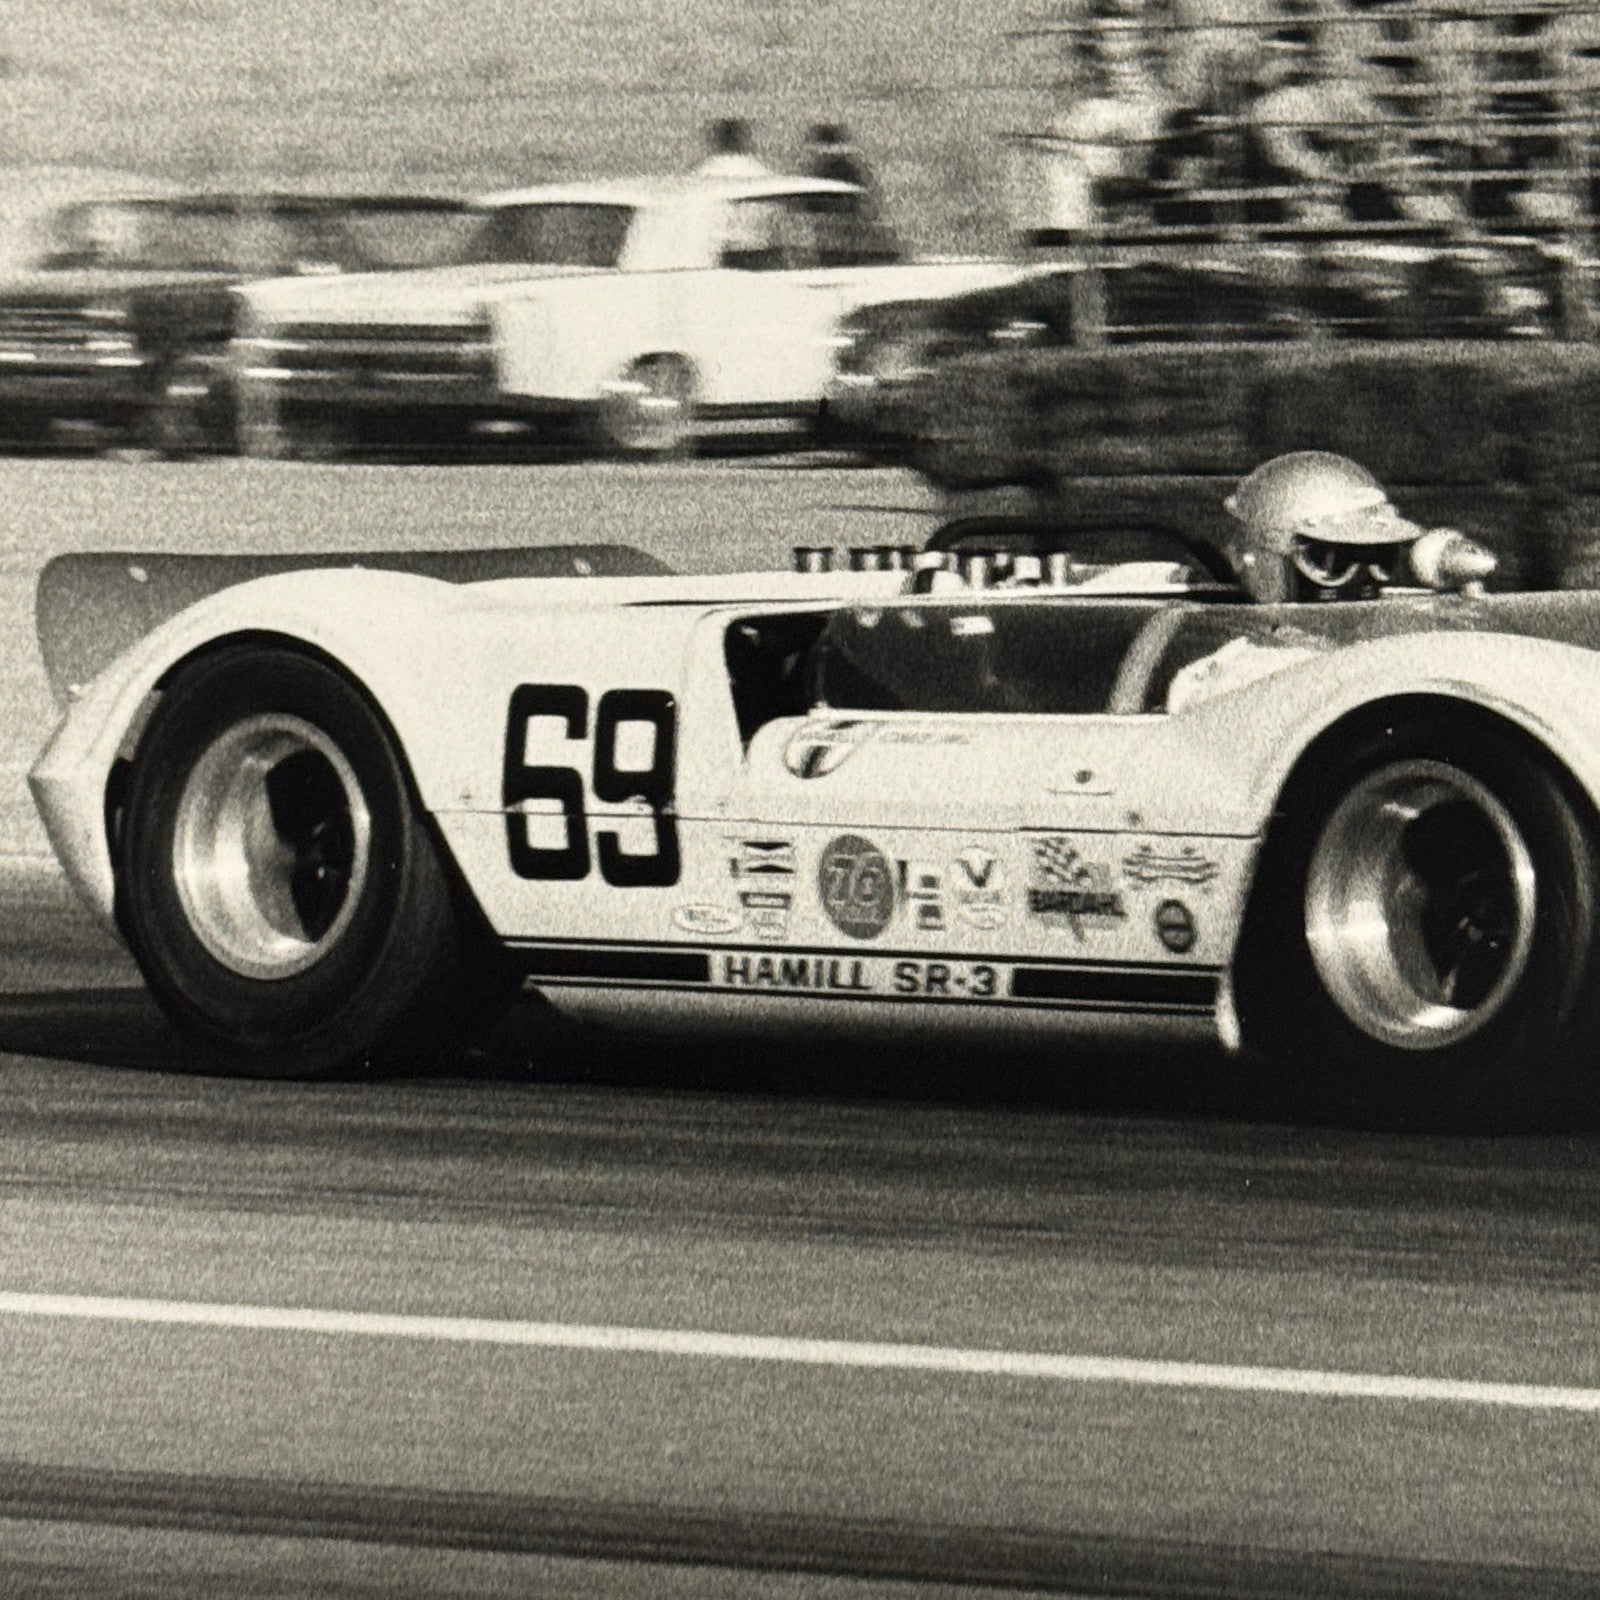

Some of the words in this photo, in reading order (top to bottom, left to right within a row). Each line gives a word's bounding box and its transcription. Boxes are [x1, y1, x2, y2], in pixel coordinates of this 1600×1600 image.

[504, 684, 680, 888] 69
[724, 956, 873, 990] HAMILL
[893, 962, 997, 998] SR-3
